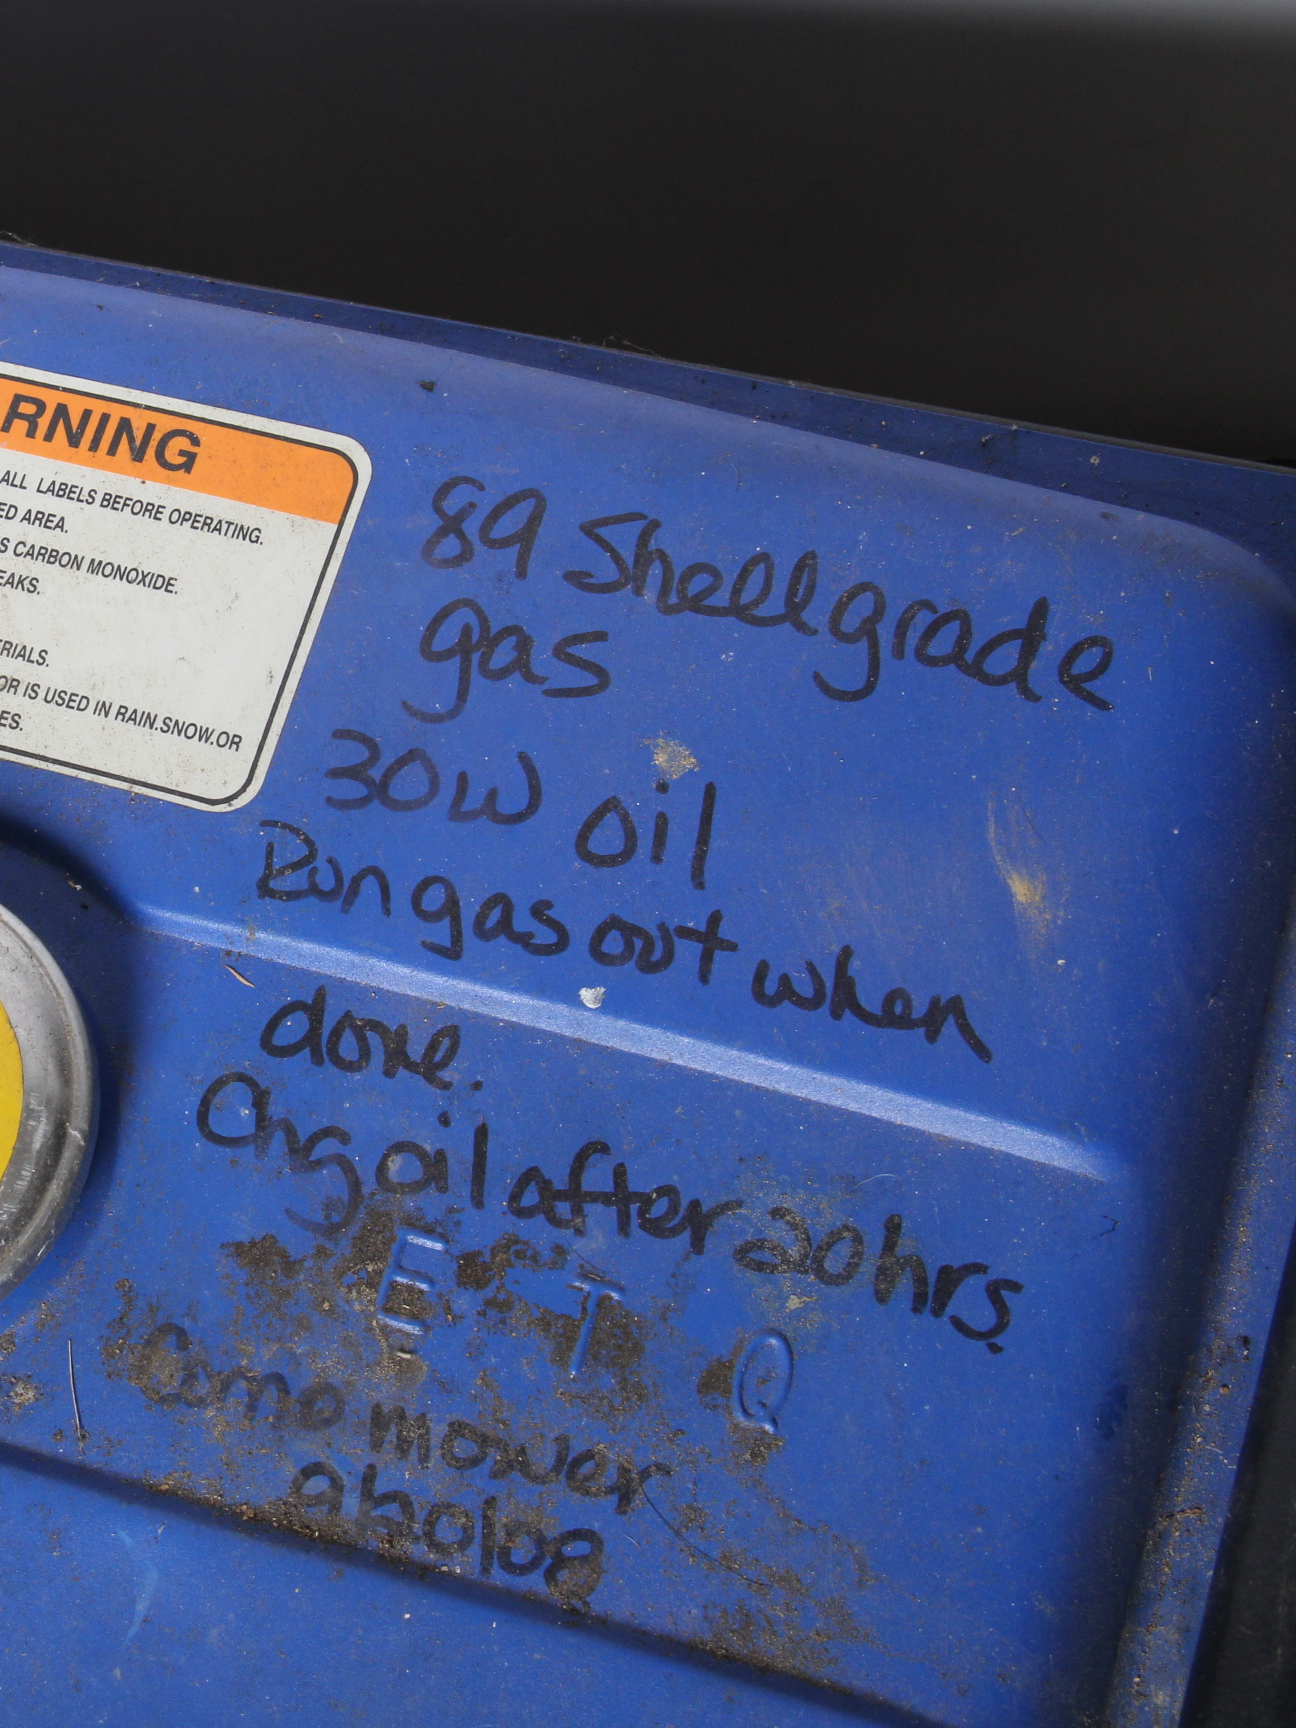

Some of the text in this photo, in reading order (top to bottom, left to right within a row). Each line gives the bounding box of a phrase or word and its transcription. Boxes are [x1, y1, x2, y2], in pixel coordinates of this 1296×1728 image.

[19, 508, 67, 533] AREA.
[36, 477, 97, 505] LABELS
[99, 491, 165, 521] BEFORE
[168, 508, 262, 544] OPERATING.
[421, 475, 547, 581] 89
[12, 540, 84, 570] CARBON
[86, 558, 177, 593] MONOXIDE.
[22, 681, 40, 700] IS
[43, 686, 90, 711] USED
[92, 699, 112, 718] IN
[402, 598, 611, 724] gas
[410, 874, 570, 962] gas
[589, 909, 739, 985] out
[751, 944, 993, 1064] when
[507, 1140, 745, 1255] after
